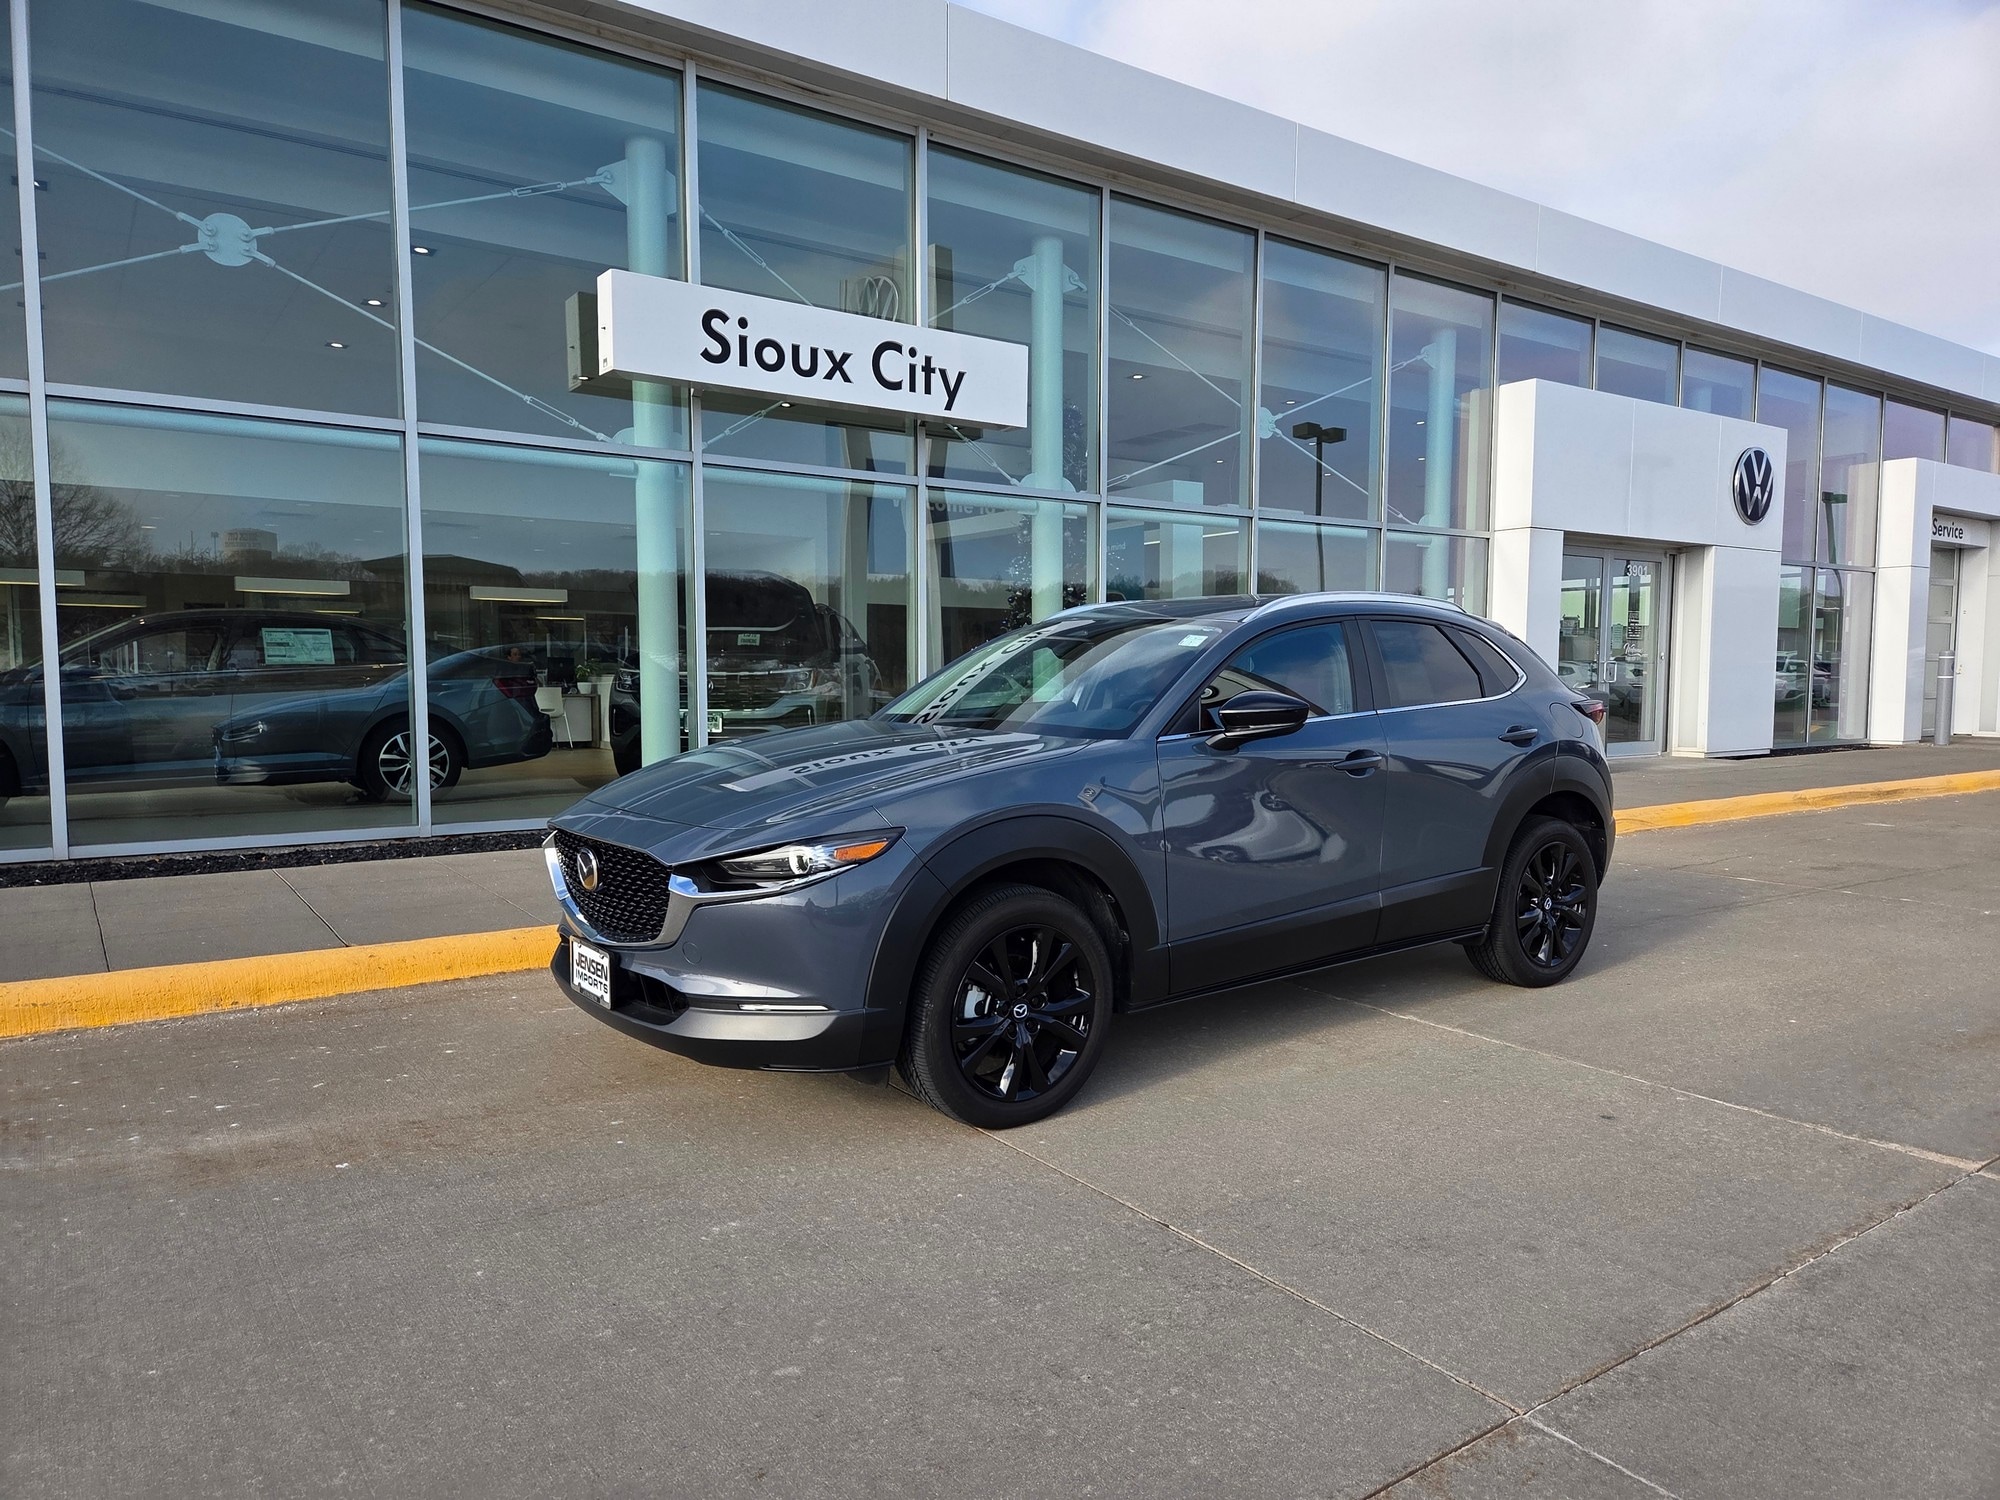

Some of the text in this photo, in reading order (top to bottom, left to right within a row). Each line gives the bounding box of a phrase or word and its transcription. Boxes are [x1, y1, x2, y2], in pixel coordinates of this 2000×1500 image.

[700, 308, 967, 411] Sioux City
[1932, 517, 1964, 539] Service
[1627, 564, 1648, 577] 3901
[576, 952, 608, 982] JENSEN
[576, 967, 608, 994] IMPORTS
